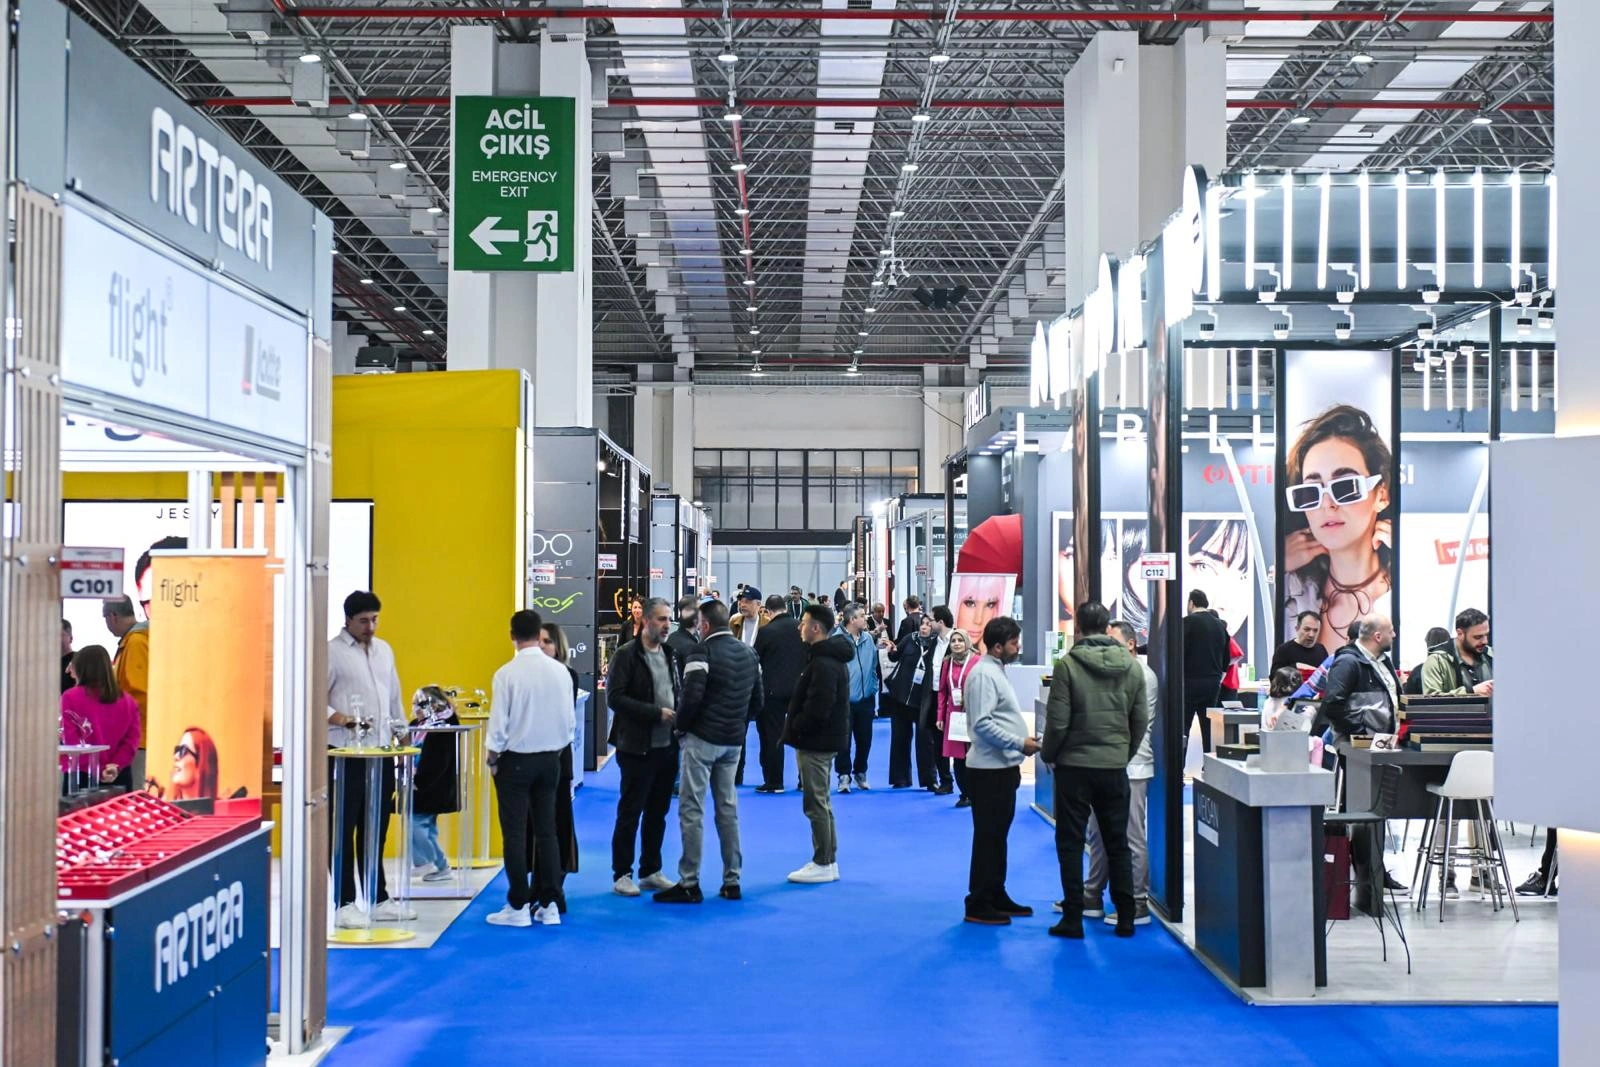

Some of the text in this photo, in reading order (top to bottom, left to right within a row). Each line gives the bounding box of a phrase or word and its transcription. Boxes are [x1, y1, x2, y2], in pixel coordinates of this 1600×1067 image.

[485, 103, 546, 130] ACİL
[479, 134, 551, 160] ÇIKIŞ
[472, 170, 558, 183] EMERGENCY
[500, 186, 529, 198] EXIT
[109, 271, 168, 388] flight
[156, 507, 220, 519] JESY
[1145, 569, 1165, 577] C112
[70, 579, 113, 594] C101
[160, 578, 199, 608] flight
